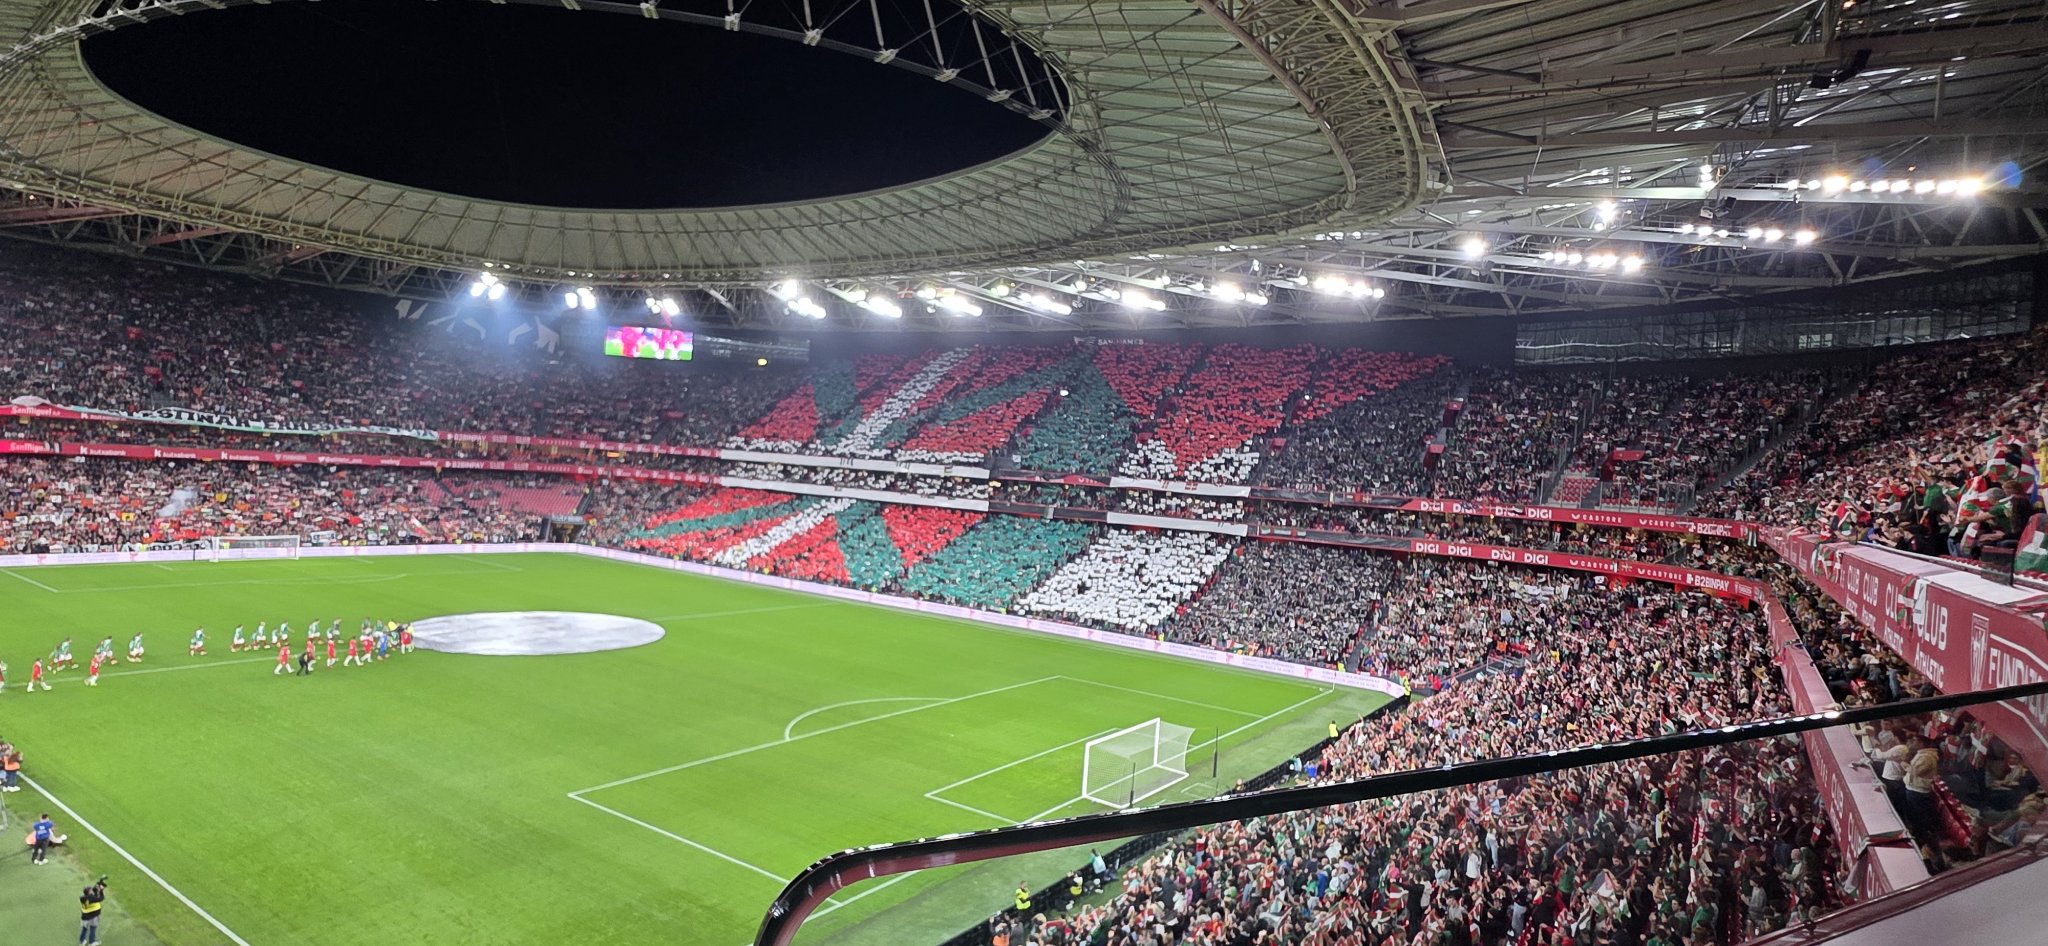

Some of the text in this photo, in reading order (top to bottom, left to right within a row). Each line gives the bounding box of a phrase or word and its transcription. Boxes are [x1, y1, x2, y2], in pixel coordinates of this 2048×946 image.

[1528, 508, 1552, 520] DIGI
[1582, 514, 1622, 523] CASTORE
[1416, 542, 1439, 554] DIGI
[1448, 545, 1472, 557] DIGI
[1524, 553, 1548, 565] DIGI
[1647, 569, 1682, 580] CASTORE
[1847, 565, 1860, 595] CLUB
[1694, 574, 1730, 591] B2BINPAY
[1863, 572, 1879, 607] CLUB
[1884, 620, 1904, 656] ATHLETIC
[1914, 642, 1944, 689] ATHLETIC
